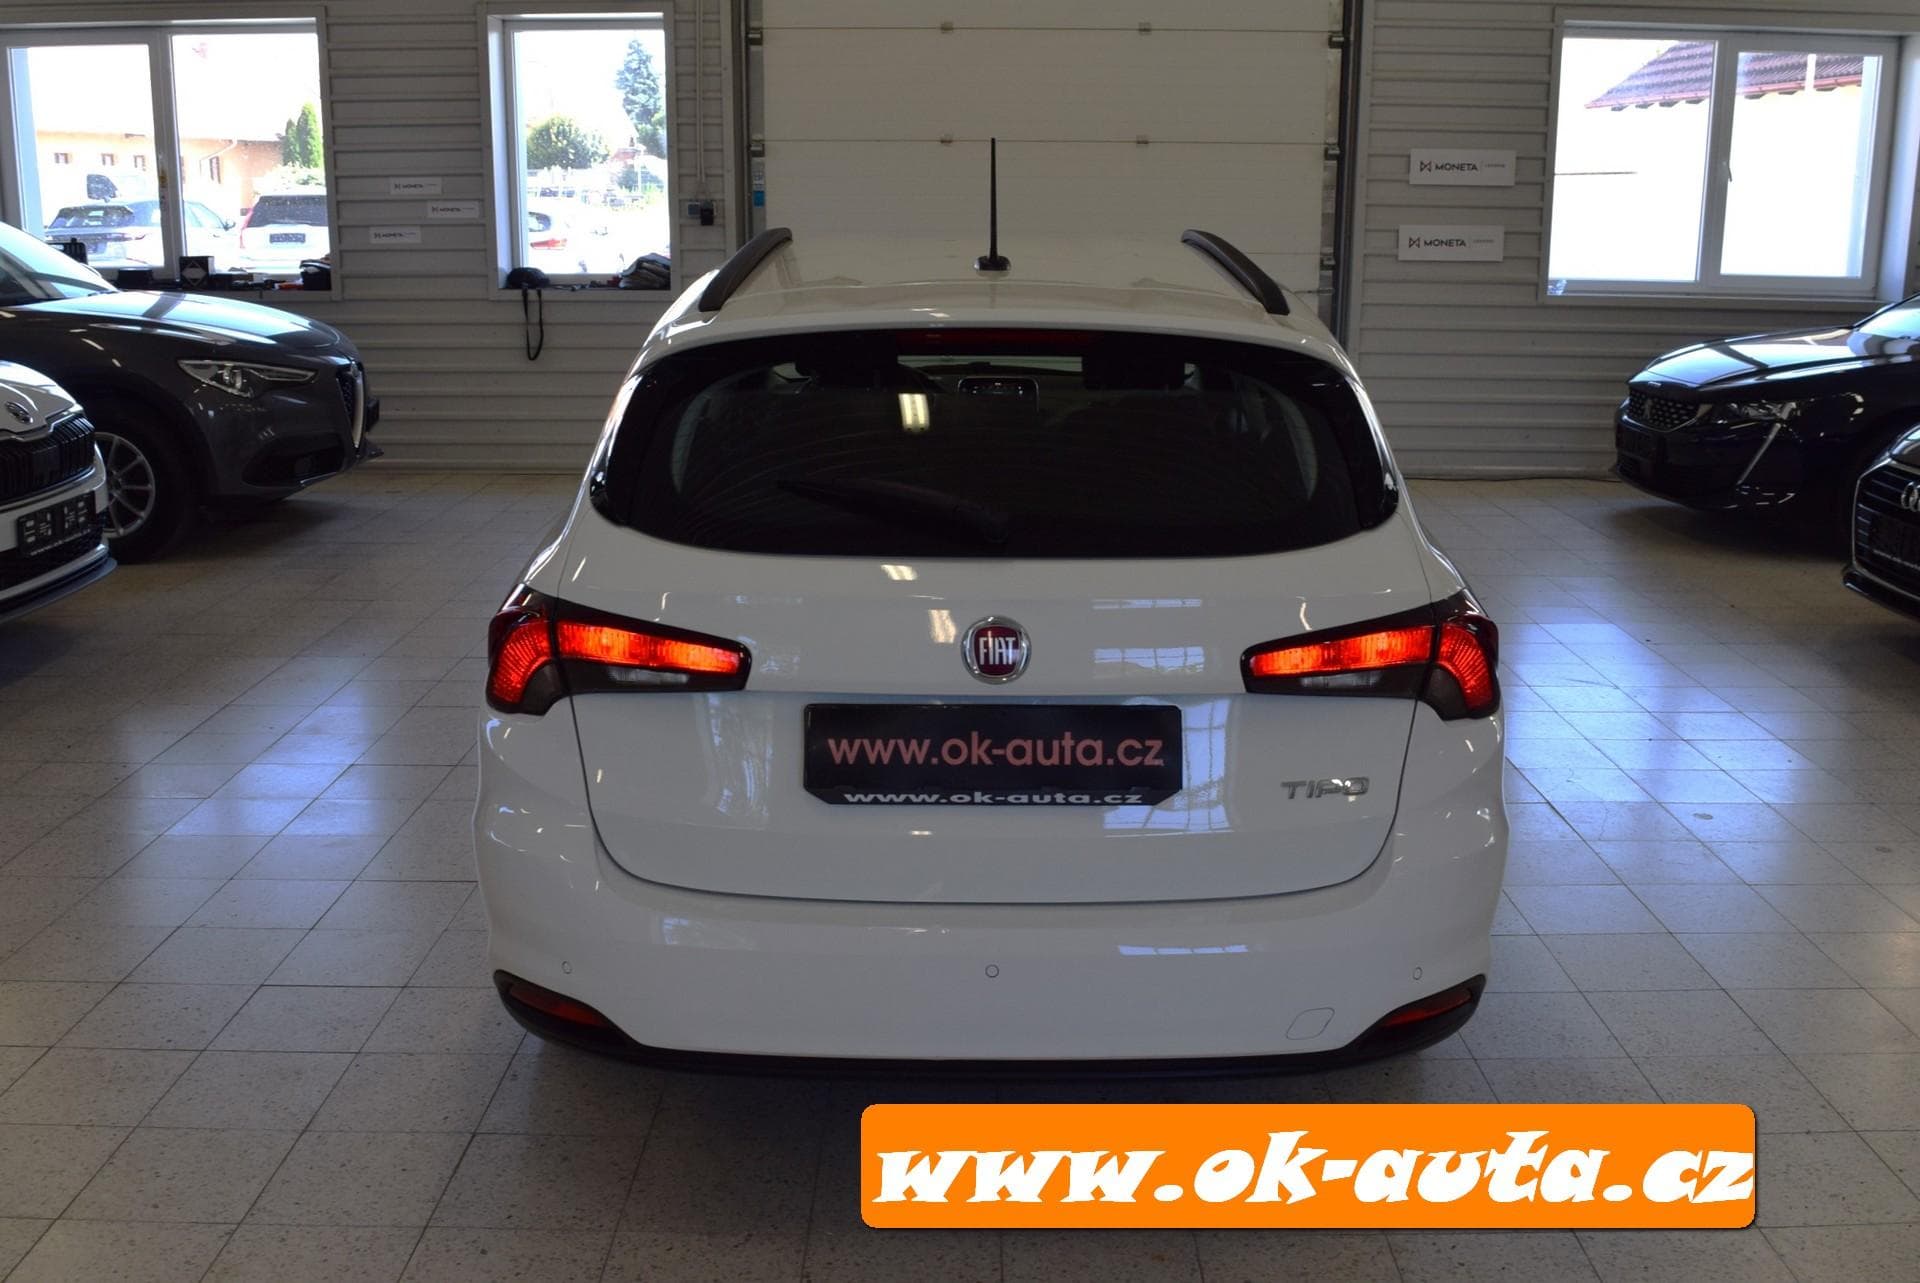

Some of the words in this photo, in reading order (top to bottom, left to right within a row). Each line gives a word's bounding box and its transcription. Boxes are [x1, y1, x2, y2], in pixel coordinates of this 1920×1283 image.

[1435, 163, 1478, 171] MONETA
[1424, 239, 1466, 247] MONETA
[979, 636, 1017, 666] FIAT
[827, 731, 1165, 767] www.ok-auta.cz
[844, 791, 1144, 804] www.ok-auta.cz
[1280, 777, 1370, 800] TIPO
